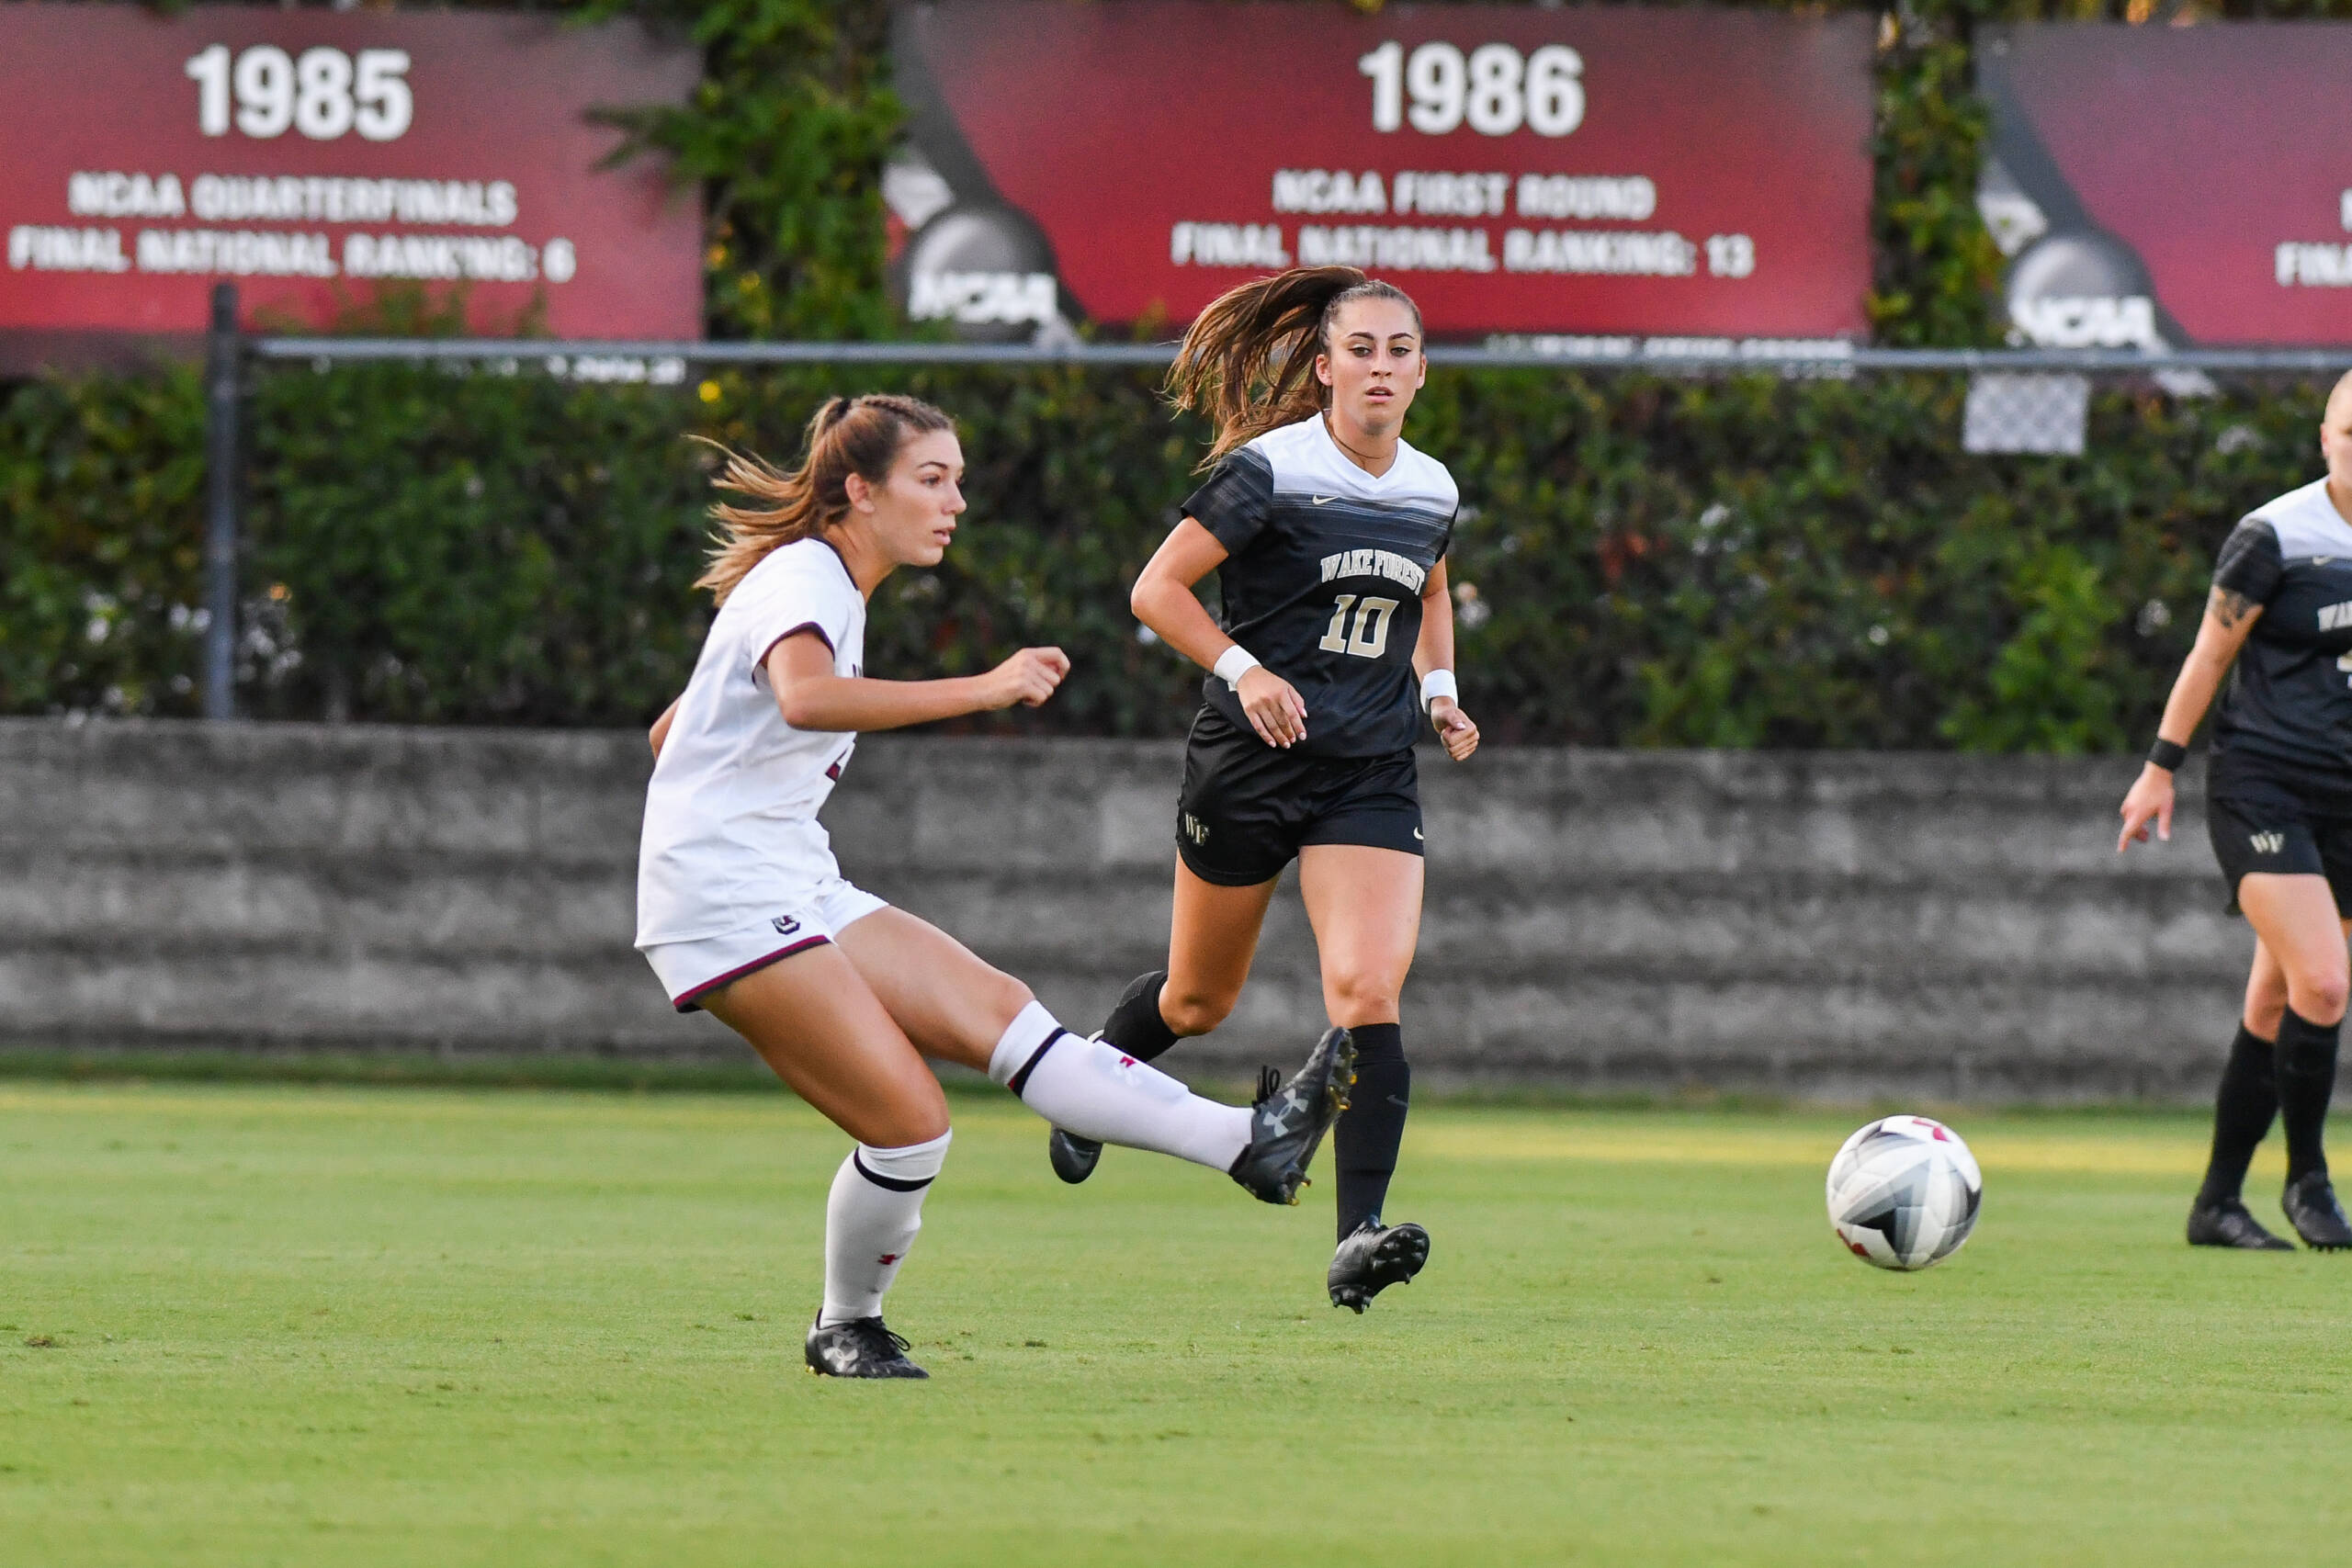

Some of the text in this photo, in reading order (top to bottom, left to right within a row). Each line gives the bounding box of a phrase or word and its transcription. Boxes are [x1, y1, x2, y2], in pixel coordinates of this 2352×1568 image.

[186, 43, 413, 141] 1985
[1359, 41, 1586, 138] 1986
[67, 170, 517, 226] NCAA QUARTERFINALS
[1272, 167, 1657, 220] NCAA FIRST ROUND
[8, 224, 131, 273] FINAL
[137, 227, 339, 276] NATIONAL
[542, 236, 577, 283] 6
[1170, 220, 1755, 278] FINAL NATIONAL RANKING: 13
[909, 272, 1058, 323] NCAA
[1320, 548, 1425, 595] WAKE FOREST
[1318, 593, 1400, 659] 10
